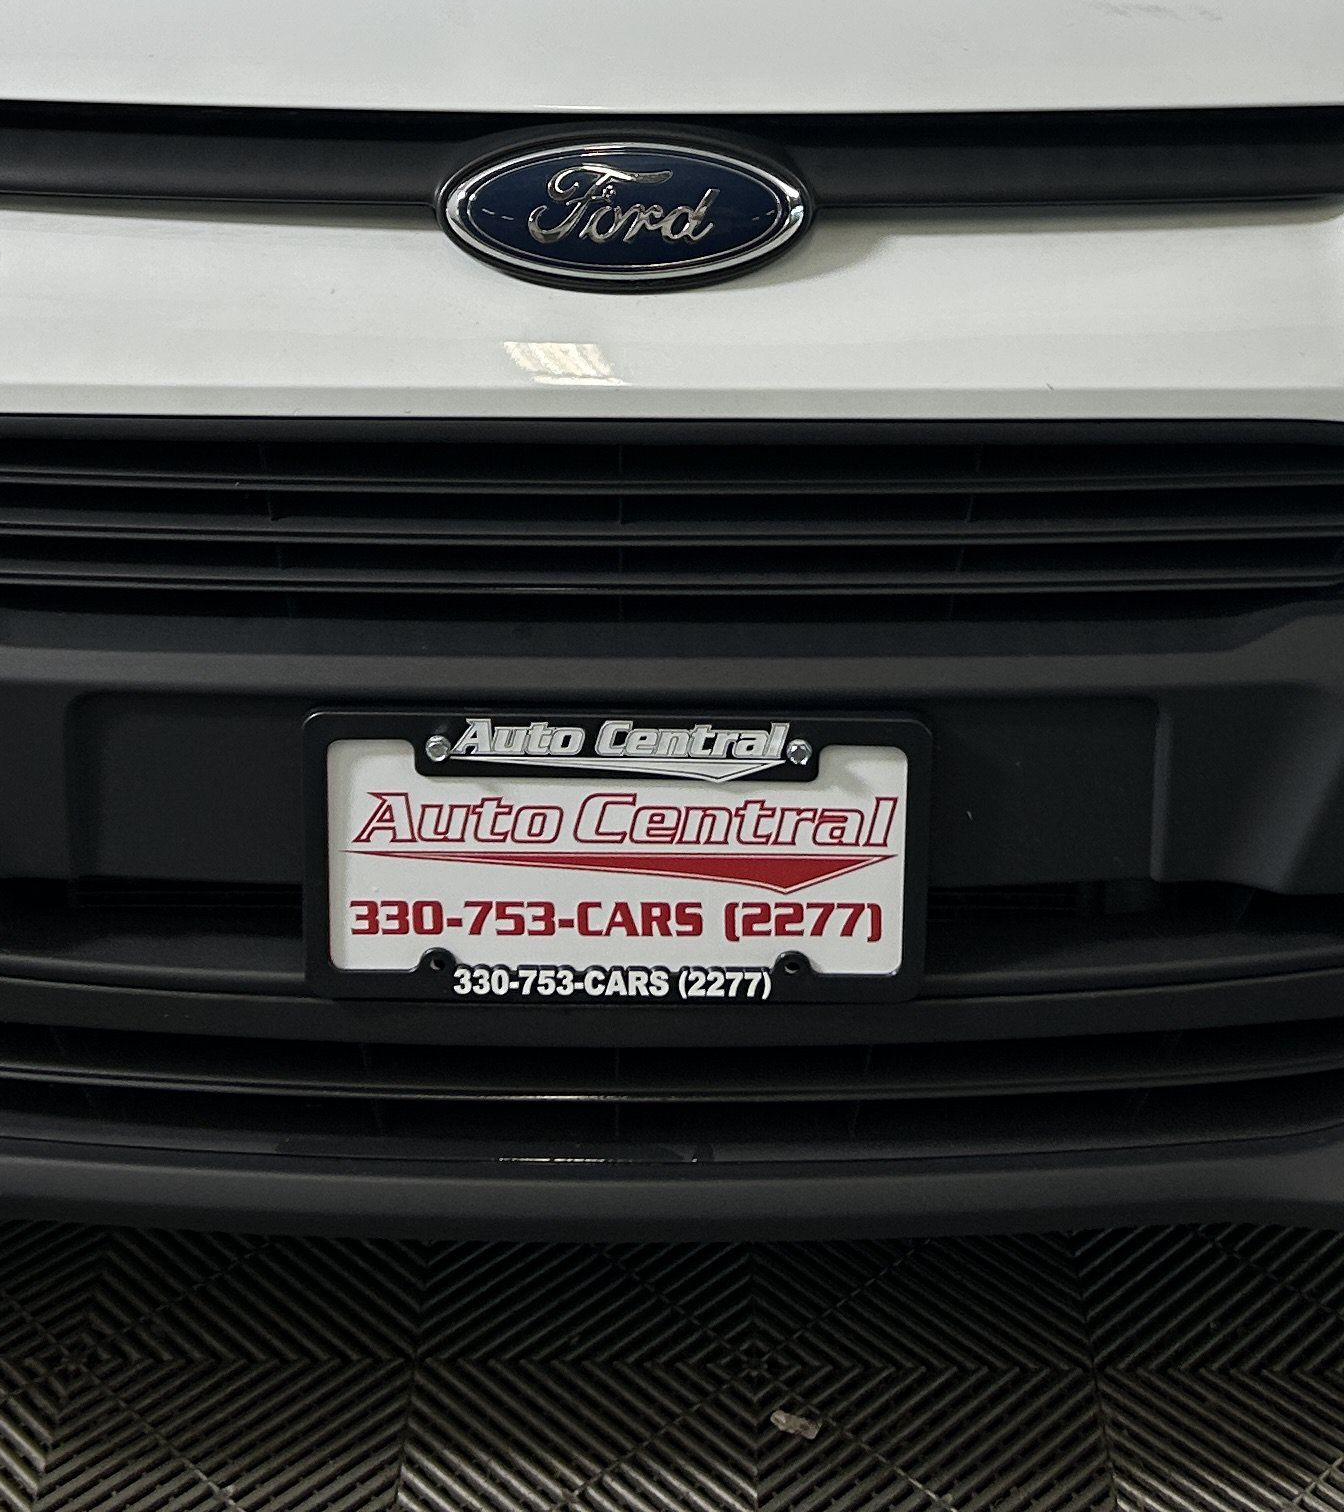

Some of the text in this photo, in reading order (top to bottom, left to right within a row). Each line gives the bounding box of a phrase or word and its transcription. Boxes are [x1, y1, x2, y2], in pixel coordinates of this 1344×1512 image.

[527, 161, 721, 244] Ford
[450, 717, 790, 760] Auto Central
[353, 791, 899, 848] Auto Central
[350, 900, 883, 943] 330-753-CARS (2277)
[452, 967, 773, 1000] 330-753-CARS (2277)
